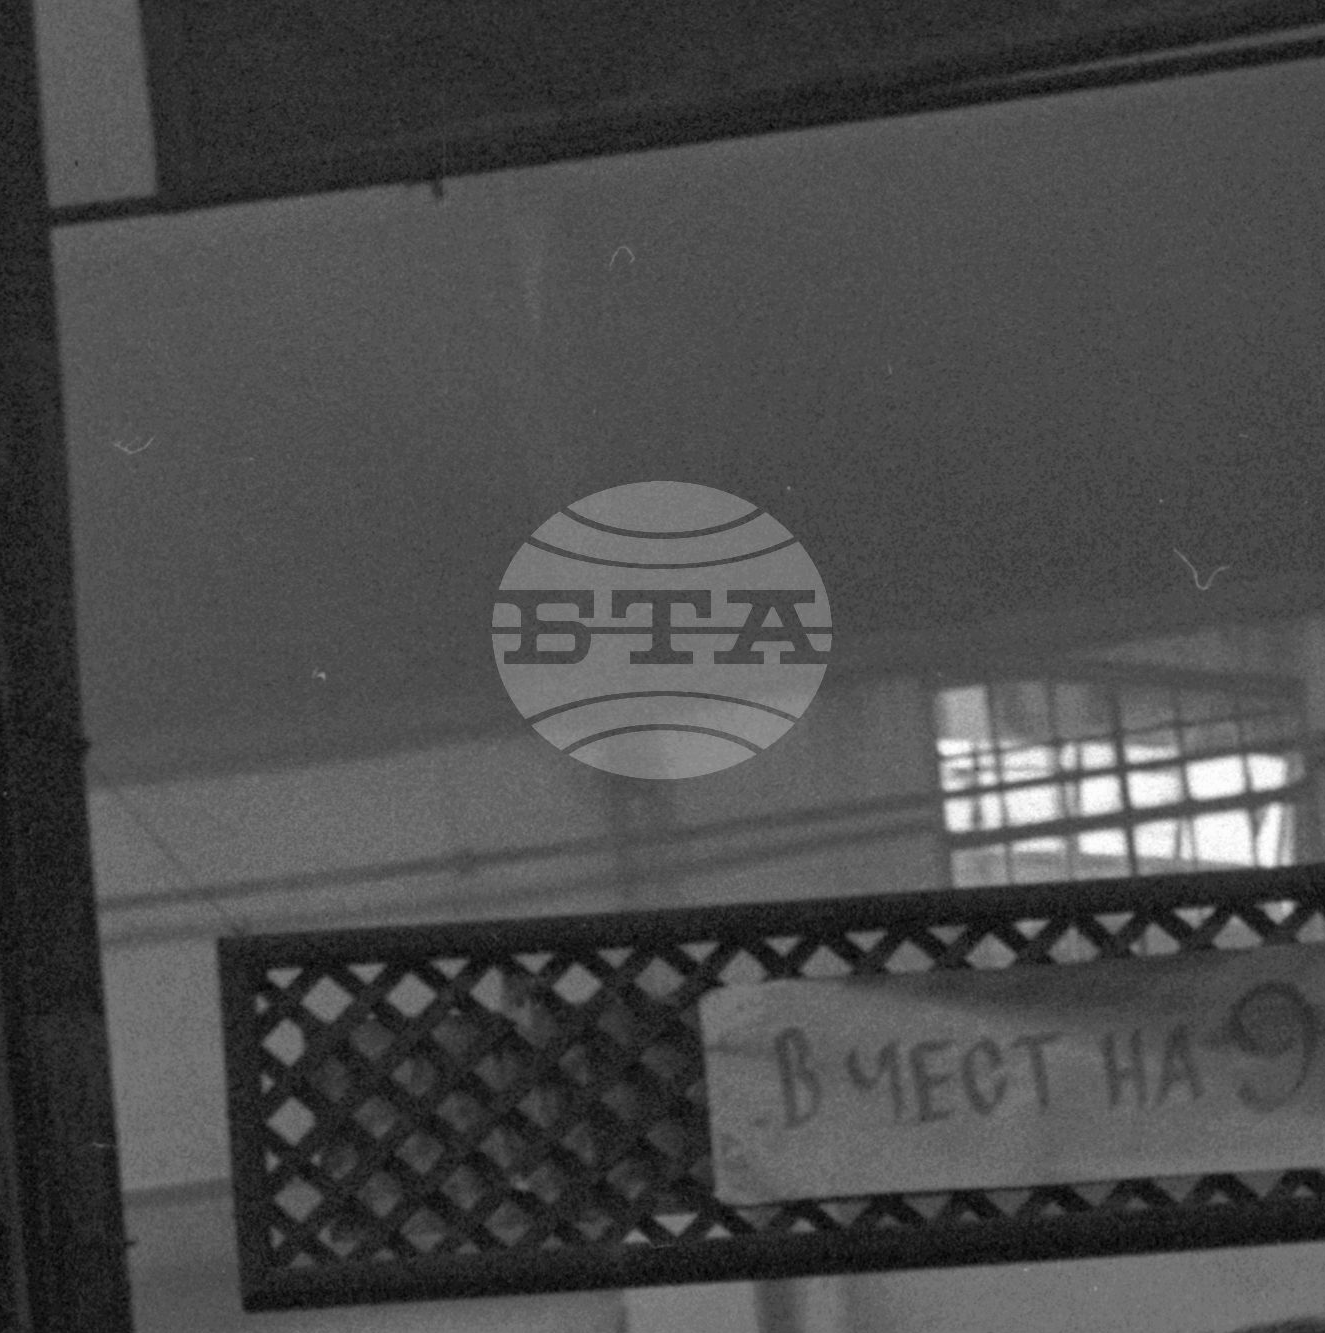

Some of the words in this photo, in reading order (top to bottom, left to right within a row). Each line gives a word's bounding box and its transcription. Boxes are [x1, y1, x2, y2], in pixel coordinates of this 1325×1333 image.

[773, 1025, 823, 1130] В
[844, 1031, 1061, 1124] ЧЕСТ
[1102, 1023, 1203, 1110] НА
